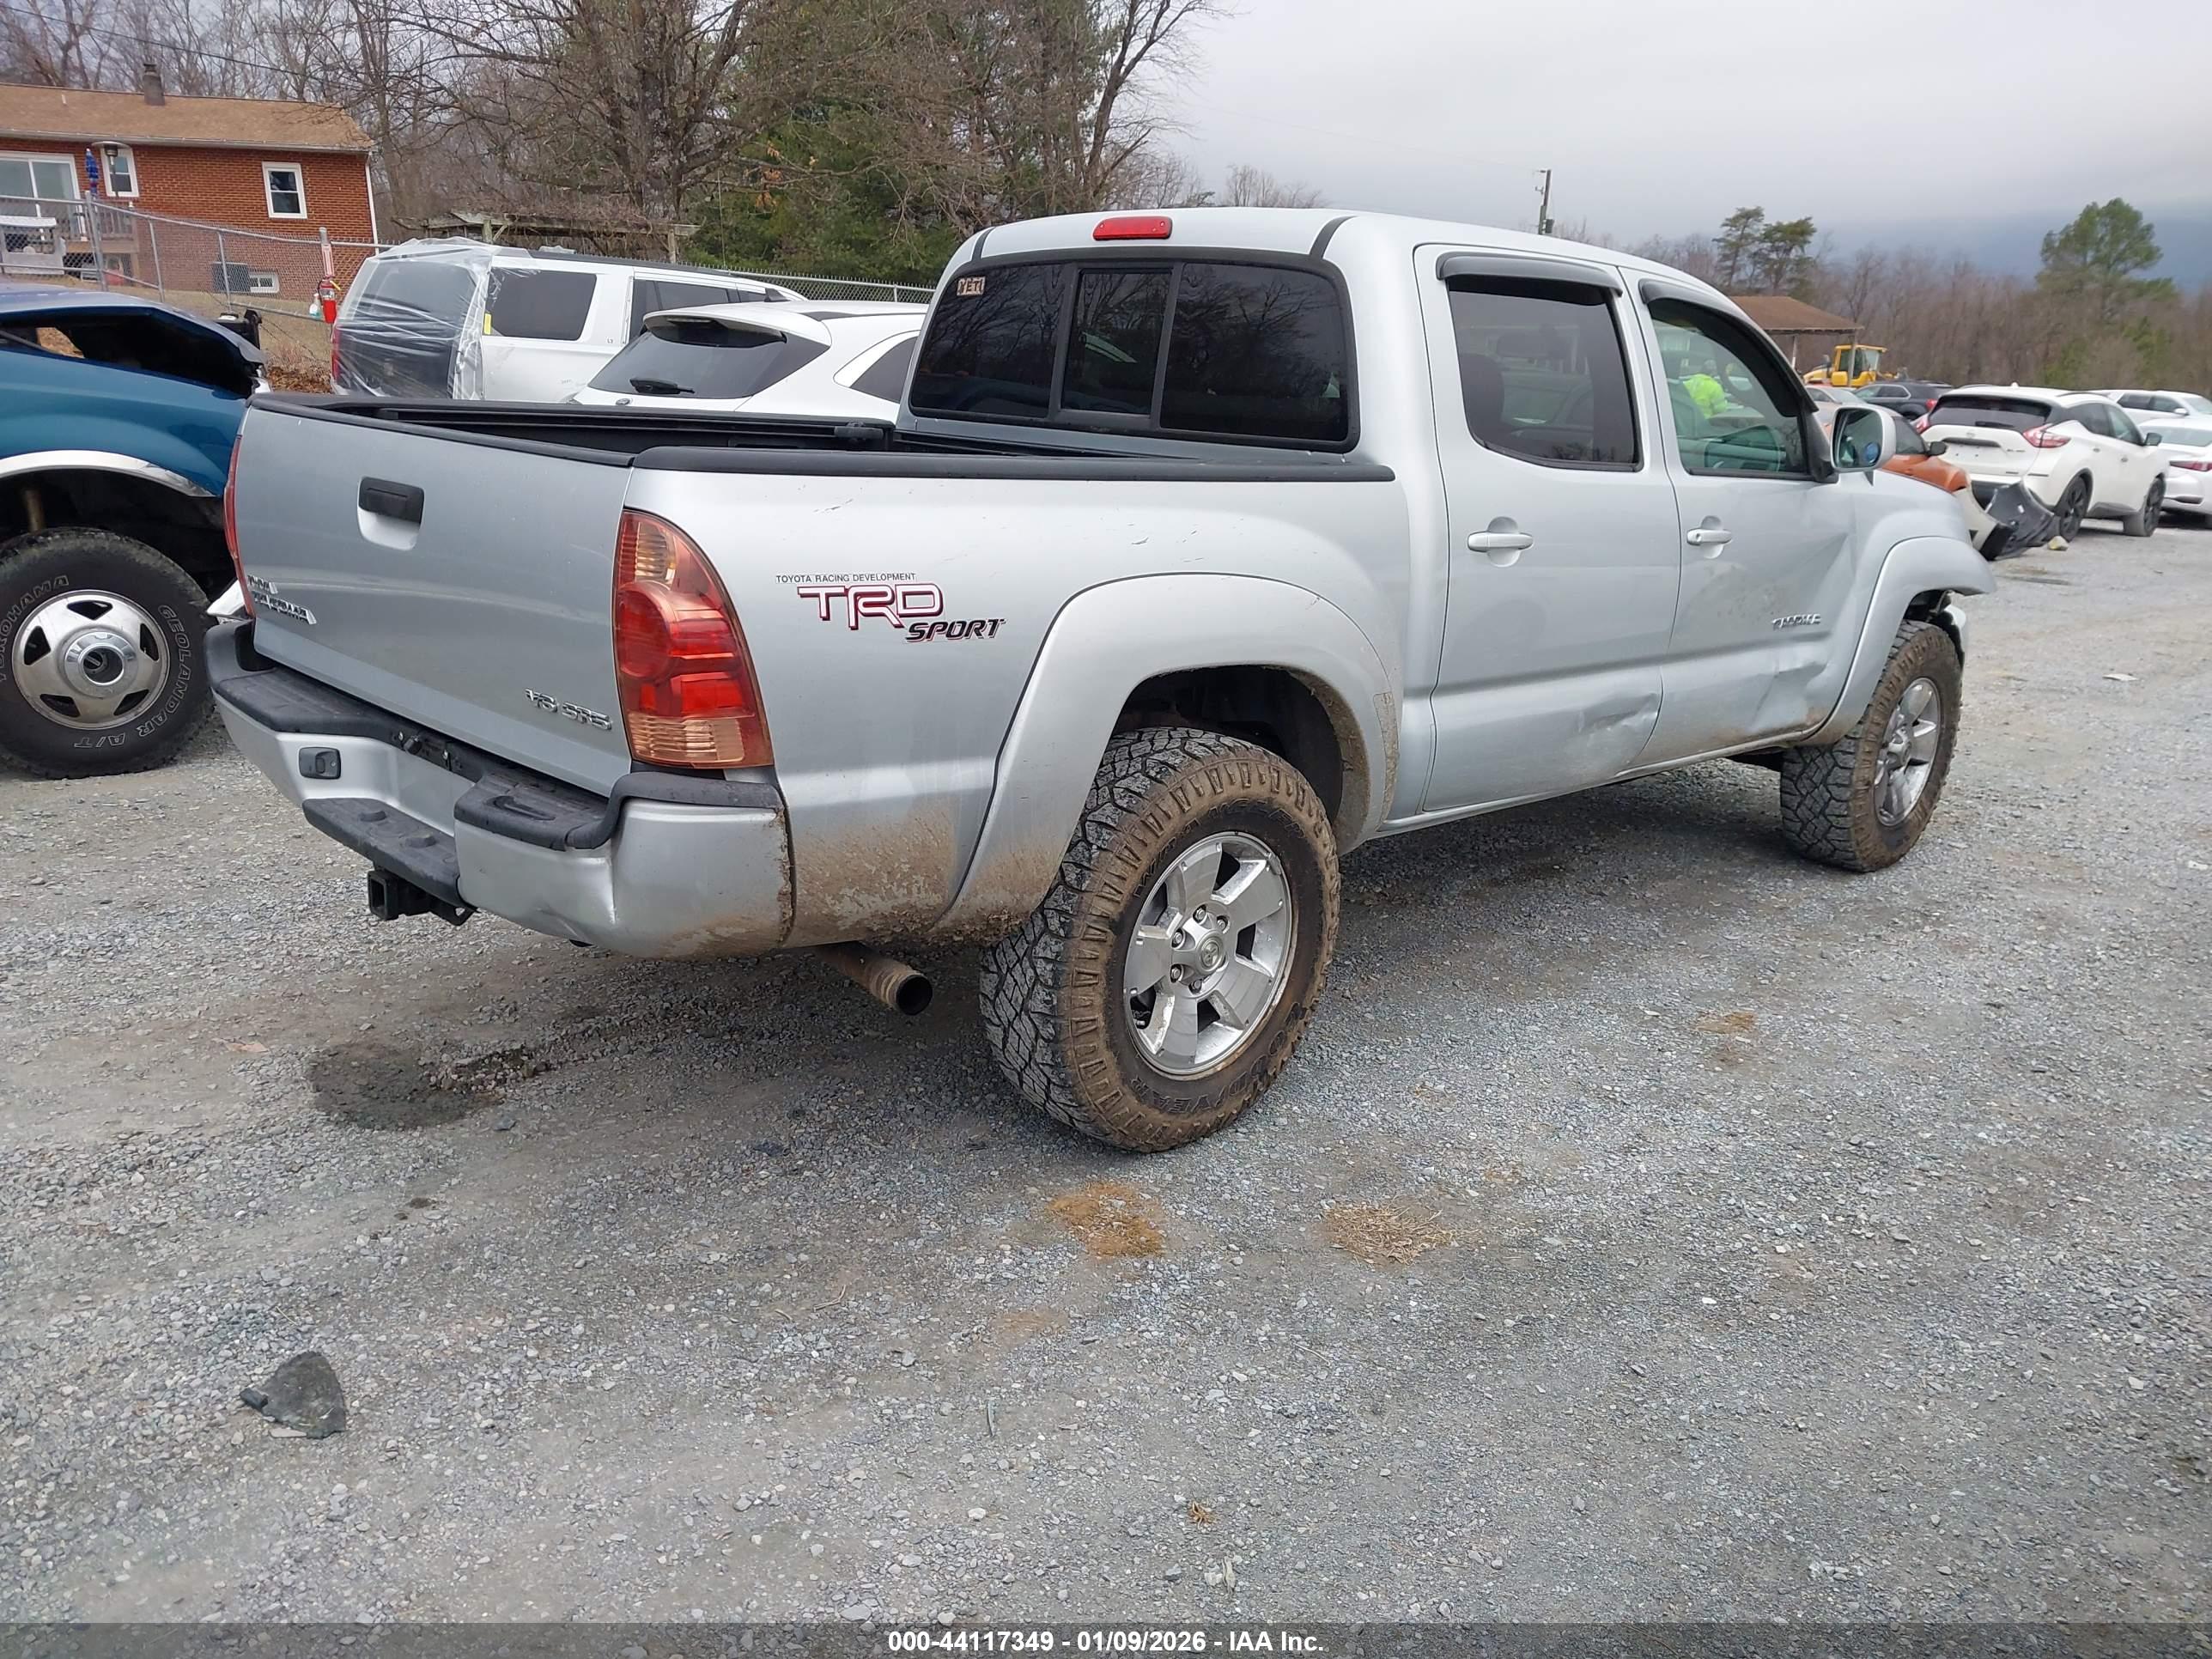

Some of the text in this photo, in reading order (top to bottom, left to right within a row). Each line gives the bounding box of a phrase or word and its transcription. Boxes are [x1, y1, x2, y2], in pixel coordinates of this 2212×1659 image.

[960, 279, 983, 293] YETI
[775, 572, 916, 583] TOYOTA RACING DEVELOPMENT
[797, 583, 944, 630] TRD
[906, 618, 1006, 642] SPORT
[74, 605, 193, 749] GEOLANDAR A/T
